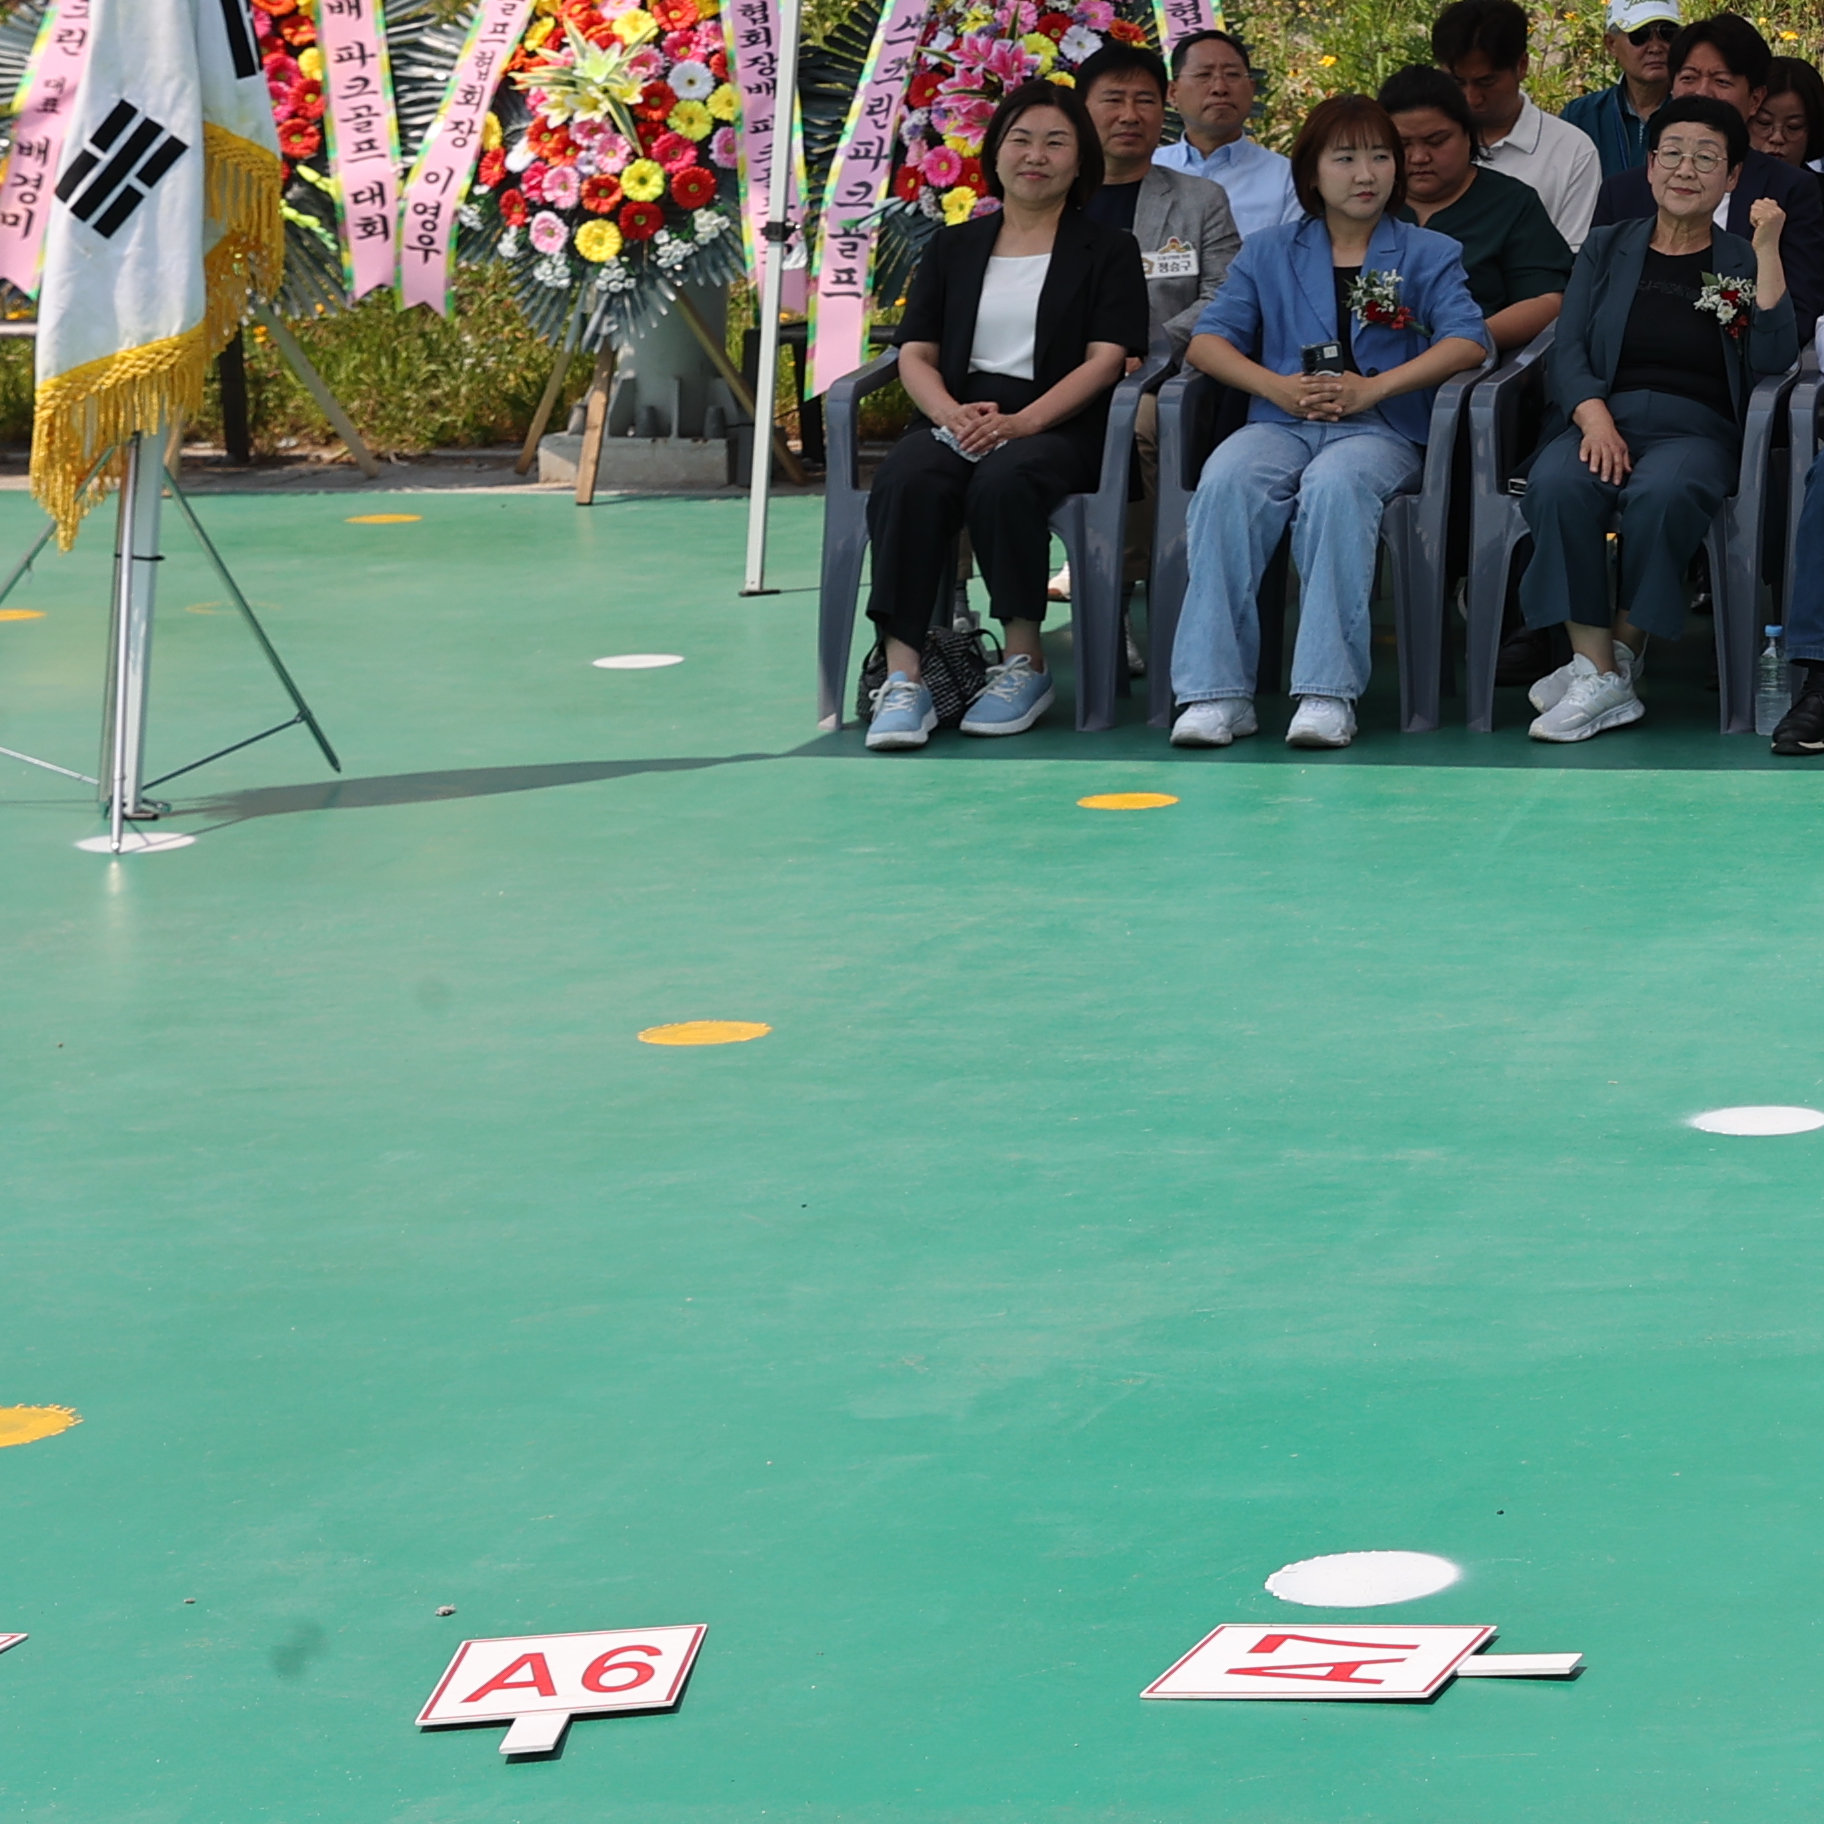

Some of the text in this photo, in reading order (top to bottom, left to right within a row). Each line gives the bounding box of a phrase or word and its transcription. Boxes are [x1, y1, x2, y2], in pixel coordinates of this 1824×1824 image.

[331, 41, 388, 164] 파크골프
[350, 178, 392, 243] 대회
[404, 165, 457, 267] 이영우
[459, 1643, 663, 1705] A6
[1223, 1633, 1421, 1685] A7
